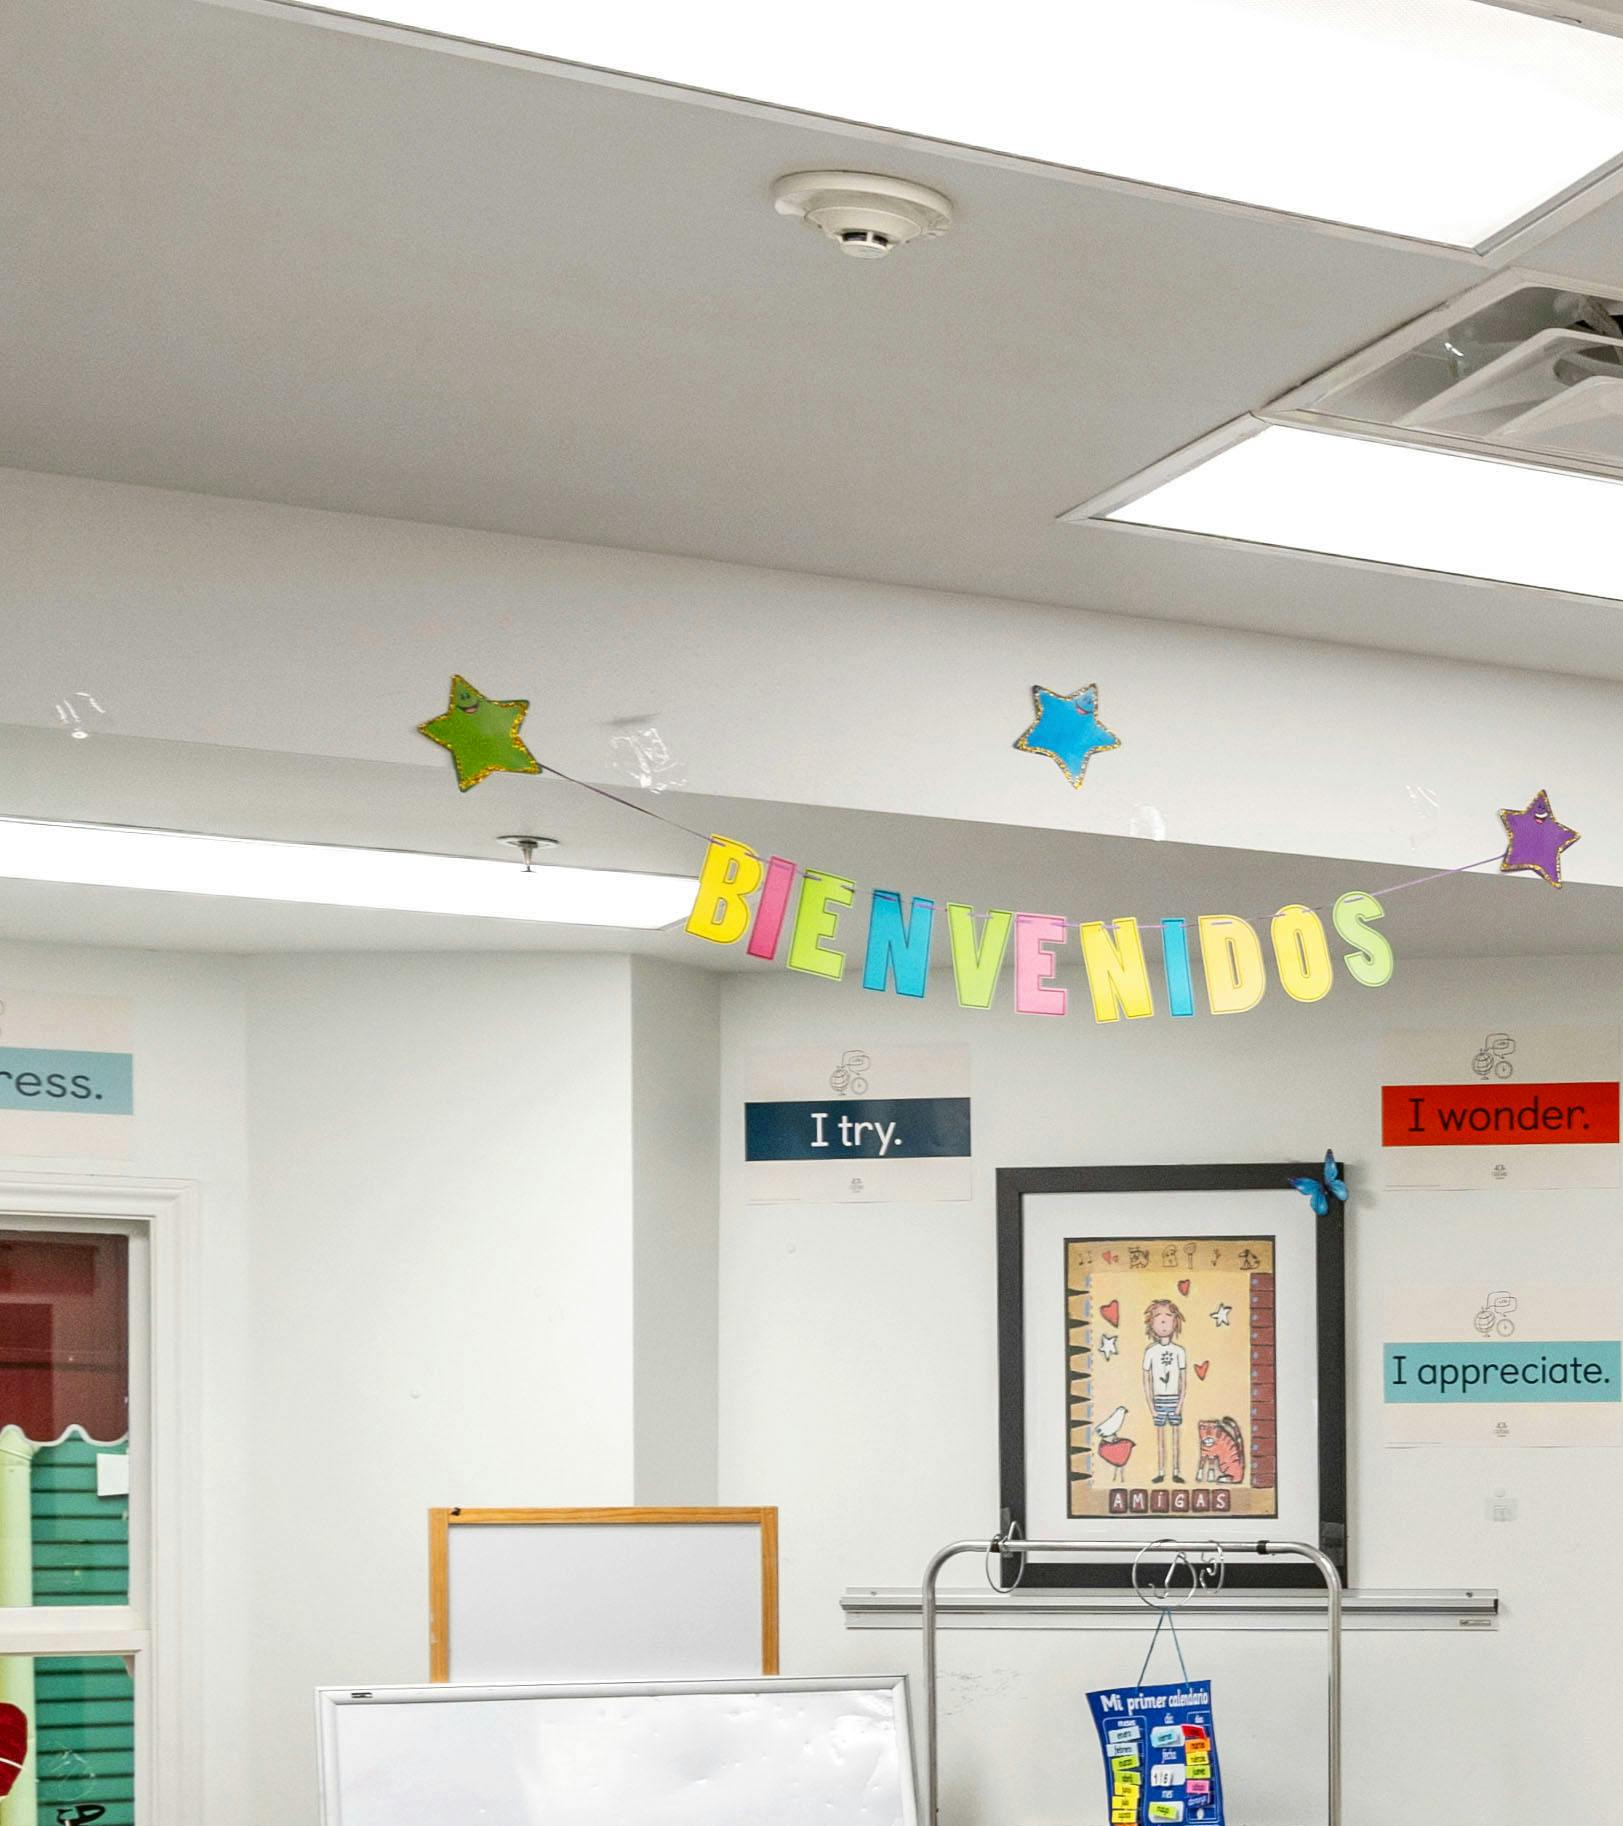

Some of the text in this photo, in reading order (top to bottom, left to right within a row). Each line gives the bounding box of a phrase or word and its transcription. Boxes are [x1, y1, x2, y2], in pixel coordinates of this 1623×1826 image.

[684, 833, 1393, 1024] BIENVENIDOS
[808, 1112, 904, 1154] I try.
[1407, 1095, 1593, 1135] I wonder.
[1390, 1353, 1612, 1395] I appreciate.
[1100, 1688, 1208, 1716] Mi primer calendario
